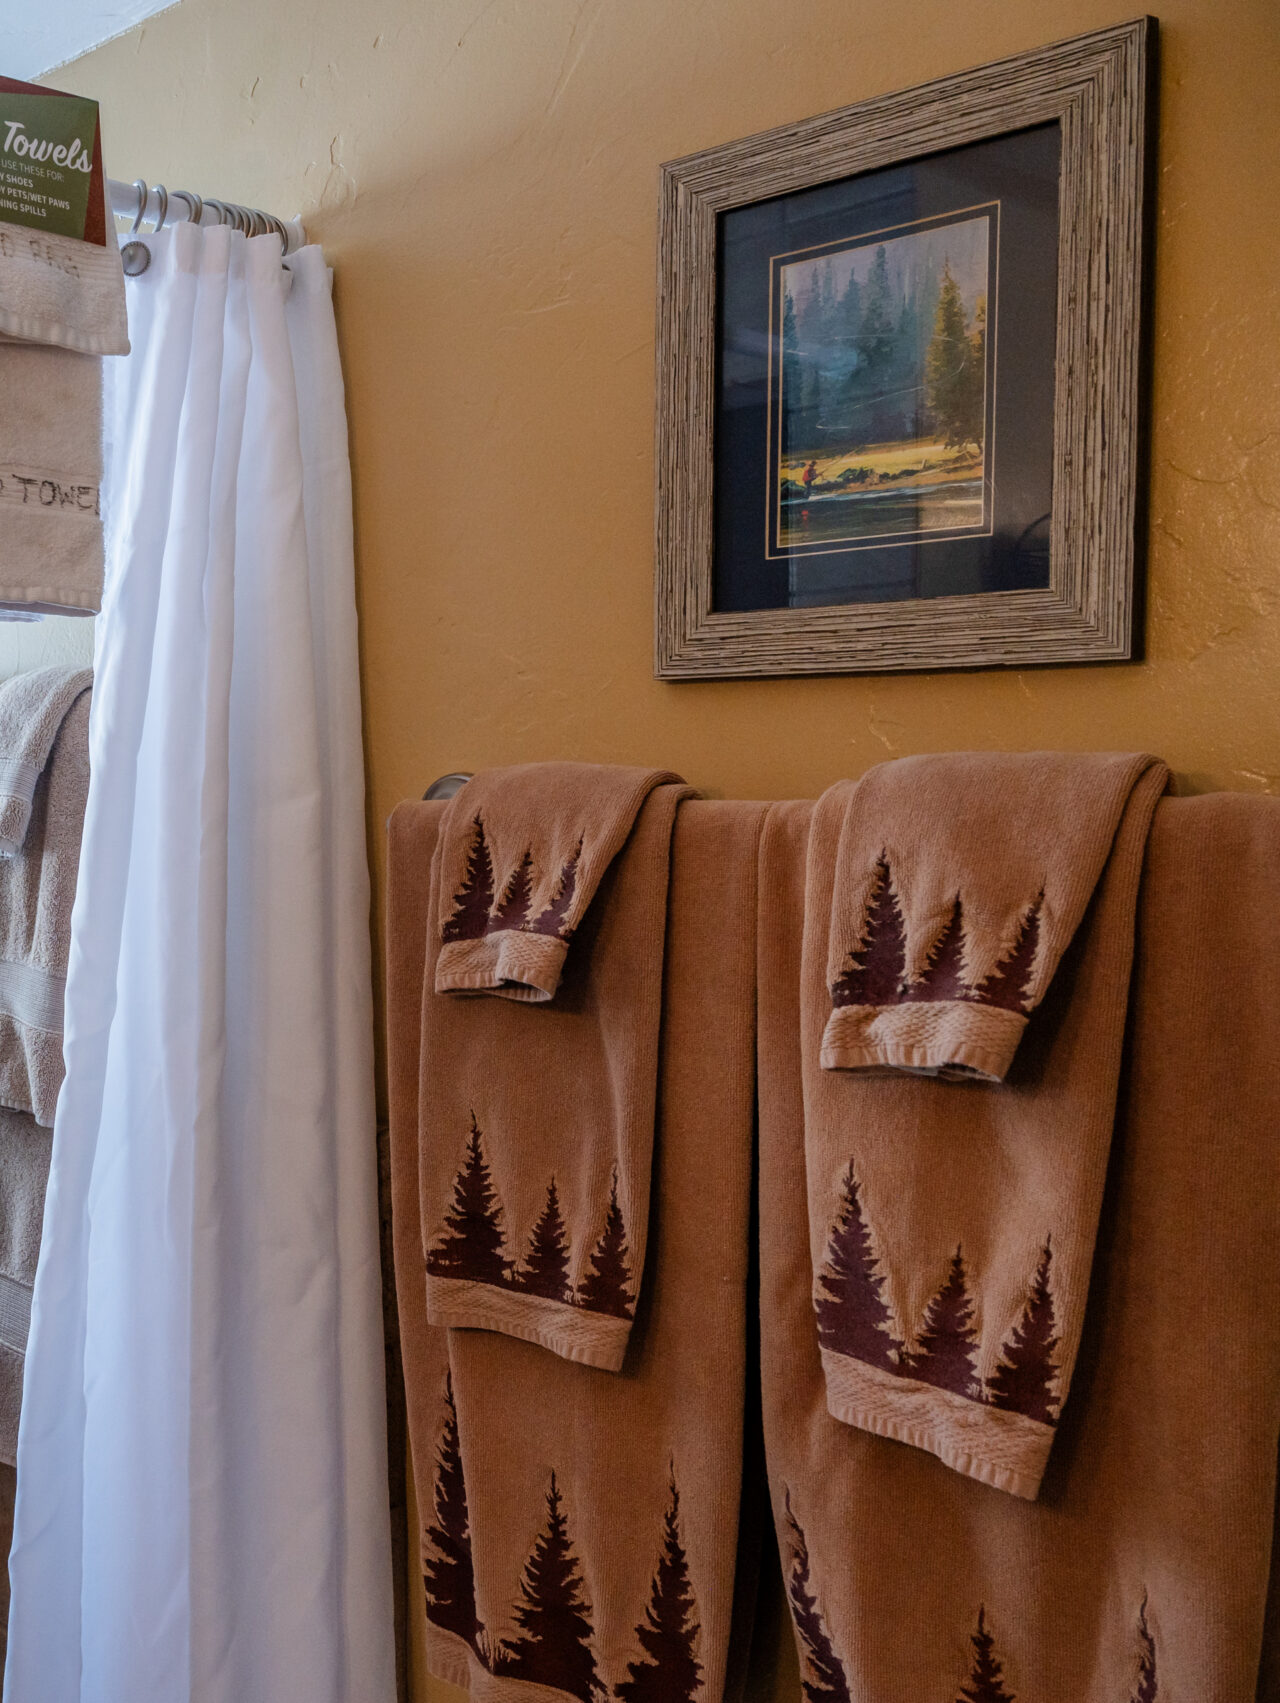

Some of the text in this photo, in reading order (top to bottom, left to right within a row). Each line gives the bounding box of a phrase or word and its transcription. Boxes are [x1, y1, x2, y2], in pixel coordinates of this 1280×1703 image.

[4, 120, 93, 173] Towels
[1, 158, 17, 171] USE
[19, 162, 45, 177] THESE
[46, 170, 65, 183] FOR:
[6, 173, 34, 188] SHOES
[7, 187, 47, 205] PETS/WET
[48, 197, 70, 211] PAWS
[19, 203, 47, 217] SPILLS
